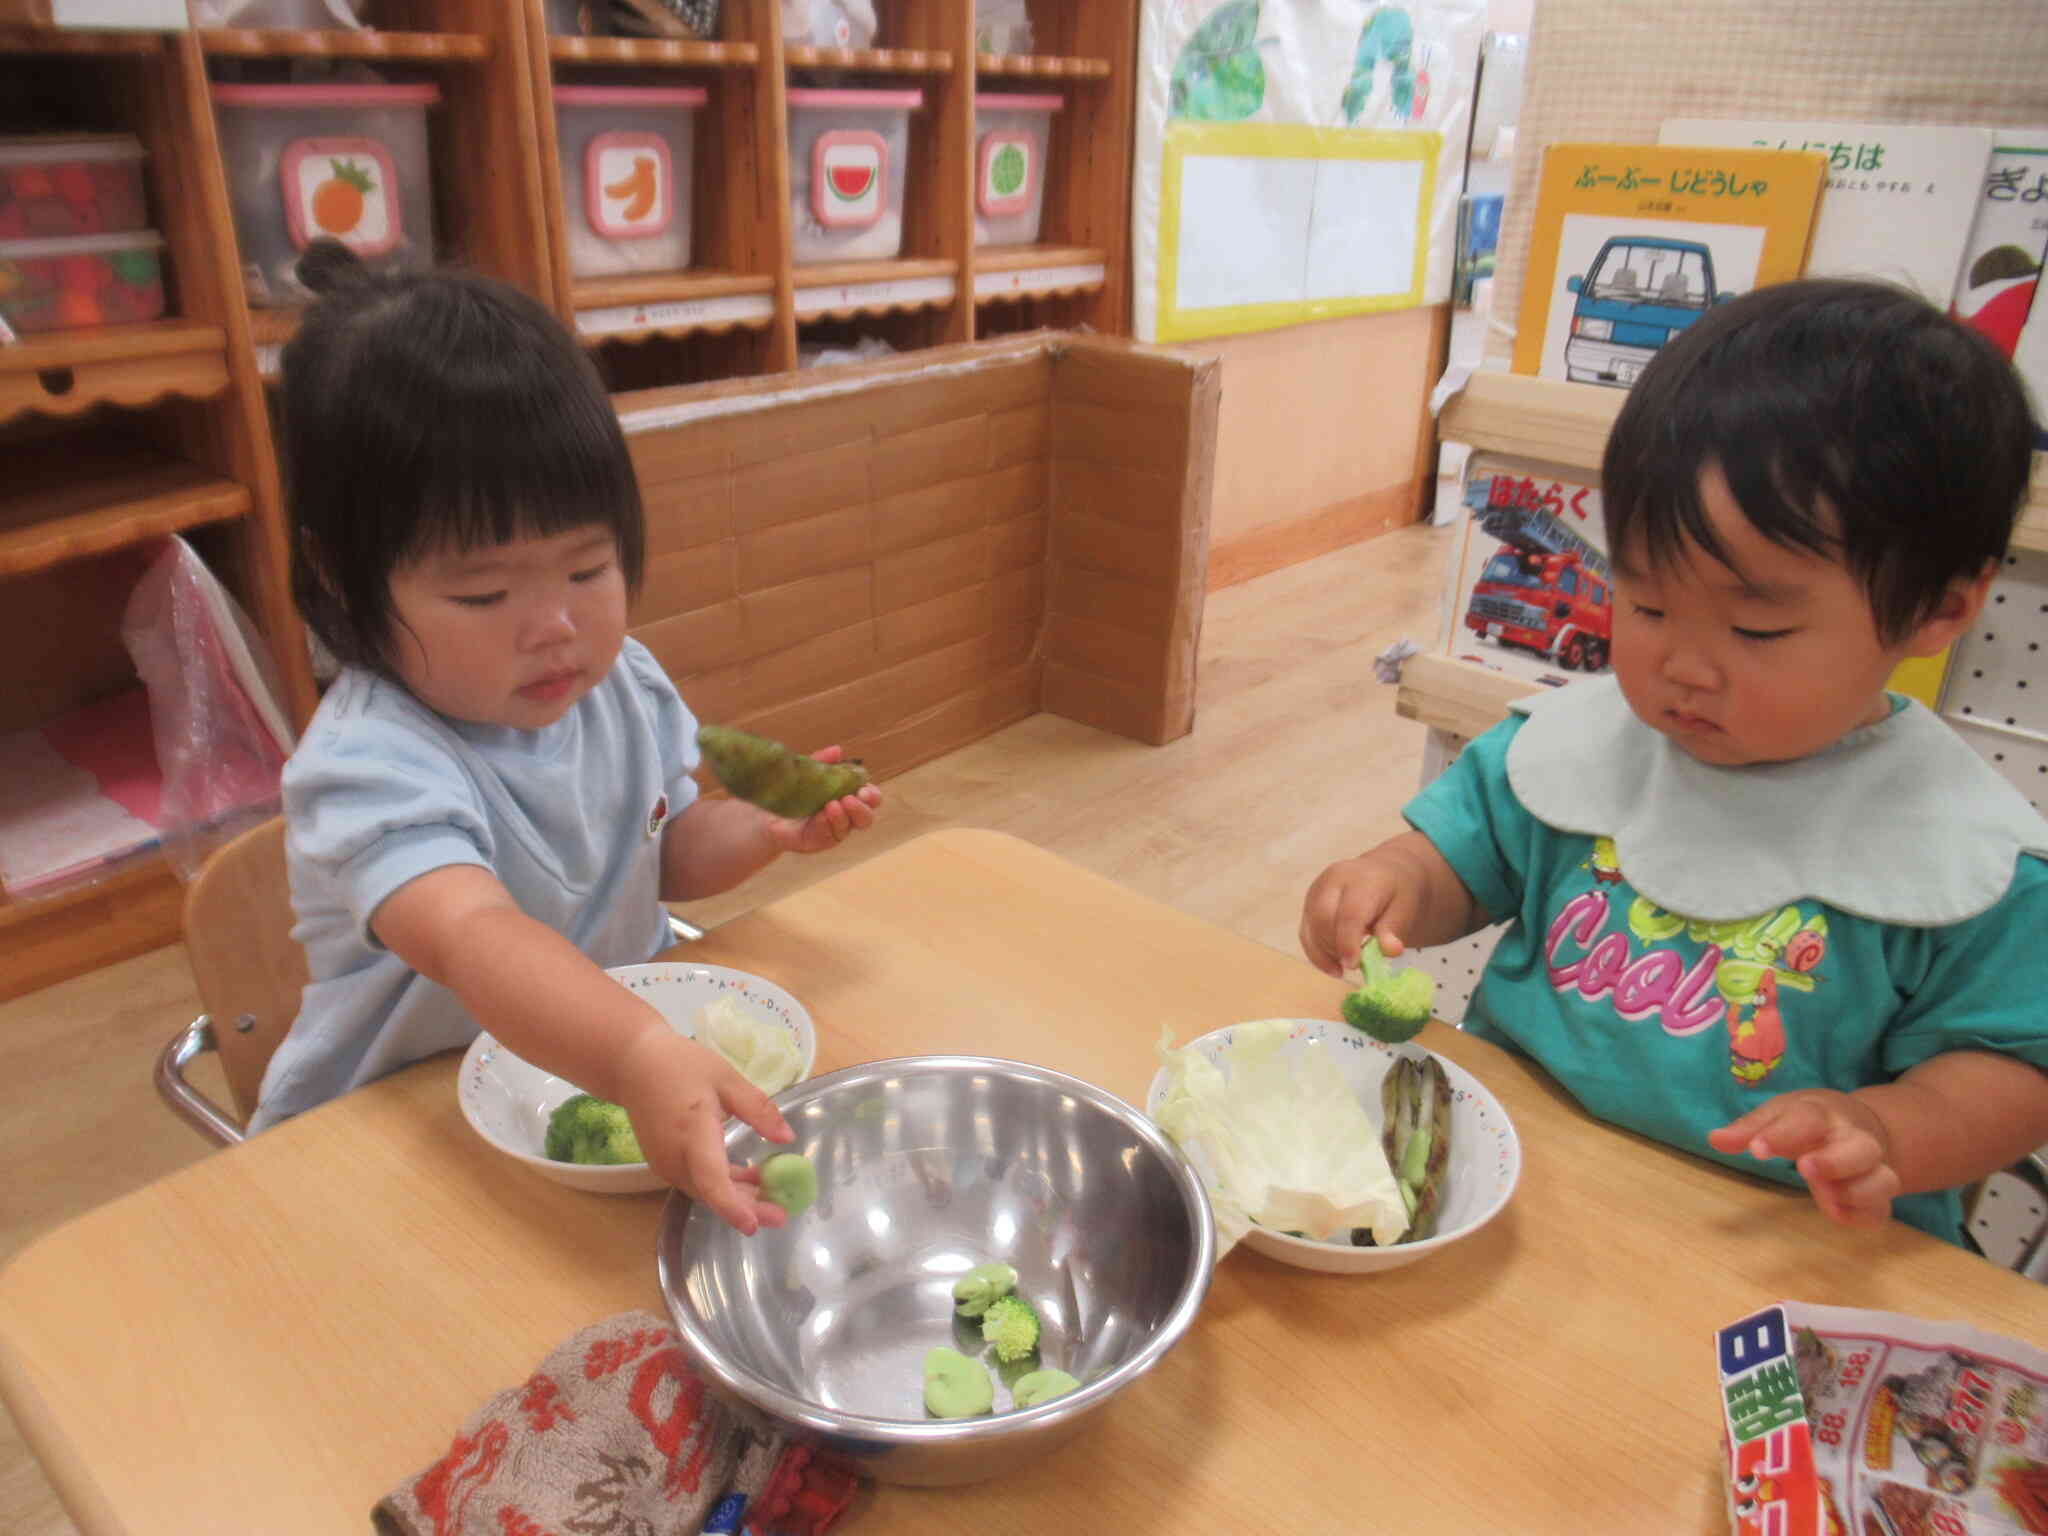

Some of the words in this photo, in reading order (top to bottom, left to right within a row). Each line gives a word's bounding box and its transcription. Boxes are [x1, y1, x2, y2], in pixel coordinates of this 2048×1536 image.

[1669, 168, 1768, 197] じどうしゃ
[1487, 475, 1590, 520] はたらく
[1546, 890, 1725, 1036] Cool
